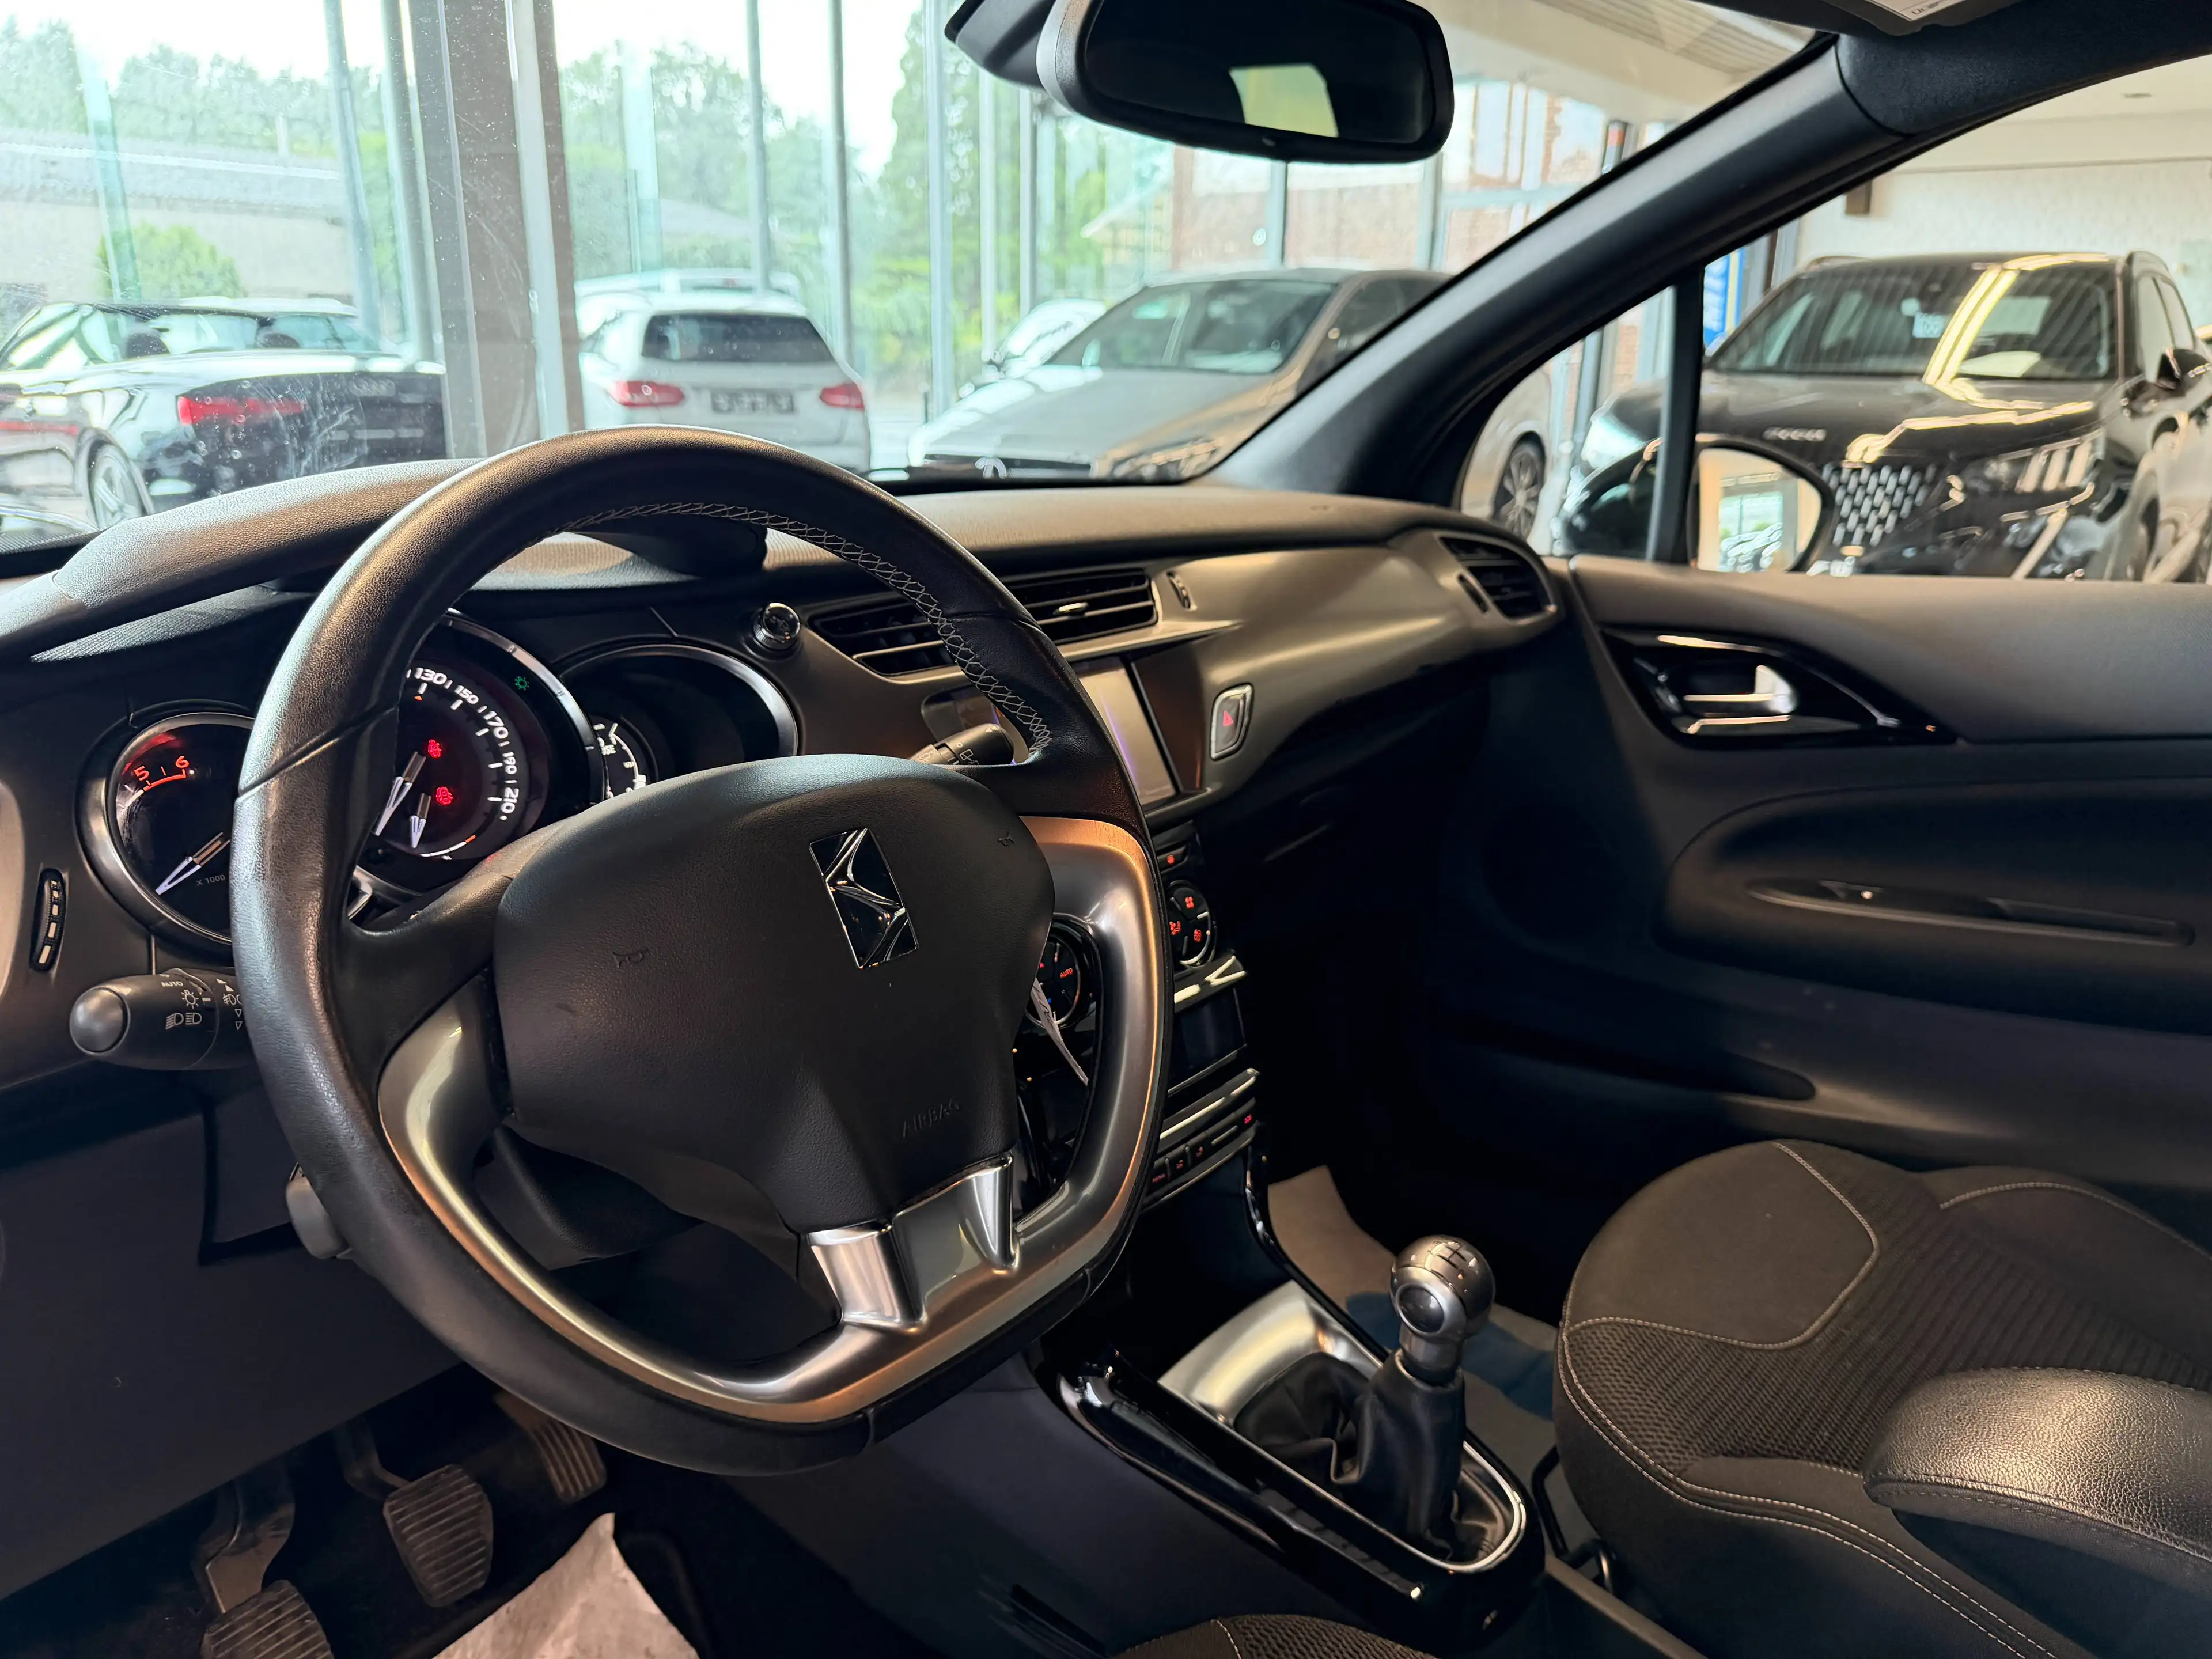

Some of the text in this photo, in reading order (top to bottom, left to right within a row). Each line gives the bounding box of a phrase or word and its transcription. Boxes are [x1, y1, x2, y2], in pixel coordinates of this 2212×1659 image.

[414, 667, 520, 814] 130 150 170 190 210
[134, 755, 190, 781] 5 6
[205, 874, 226, 885] 1000
[1060, 968, 1073, 978] AUTO
[902, 1096, 960, 1138] AIRBAG
